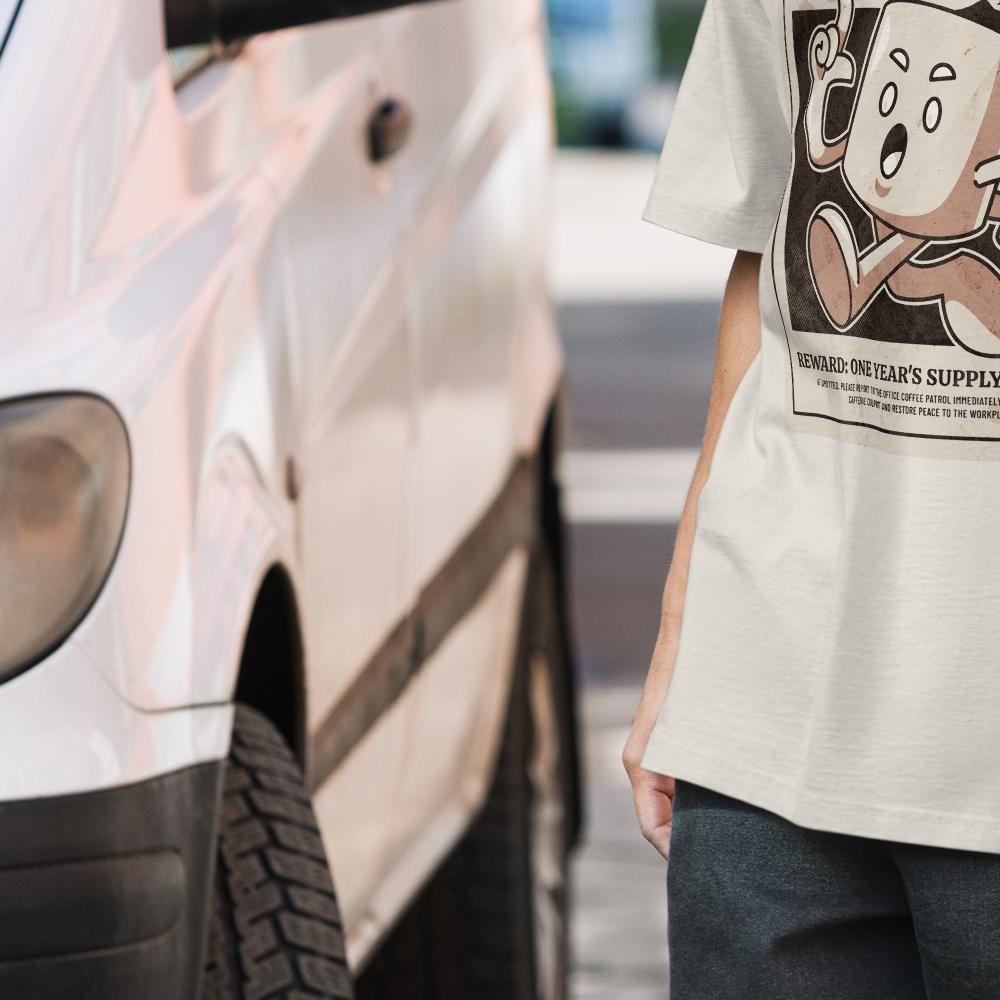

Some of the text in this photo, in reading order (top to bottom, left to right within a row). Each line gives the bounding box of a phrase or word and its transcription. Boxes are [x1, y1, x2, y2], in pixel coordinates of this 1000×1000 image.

[797, 352, 848, 374] REWARD:
[851, 358, 872, 377] ONE
[873, 362, 922, 385] YEAR'S
[882, 390, 899, 400] OFFICE
[901, 393, 923, 403] COFFEE
[925, 395, 951, 404] PATROL
[881, 403, 891, 412] AND
[891, 405, 917, 415] RESTORE
[918, 407, 940, 417] PEACE
[942, 408, 951, 418] TO
[953, 409, 968, 418] THE
